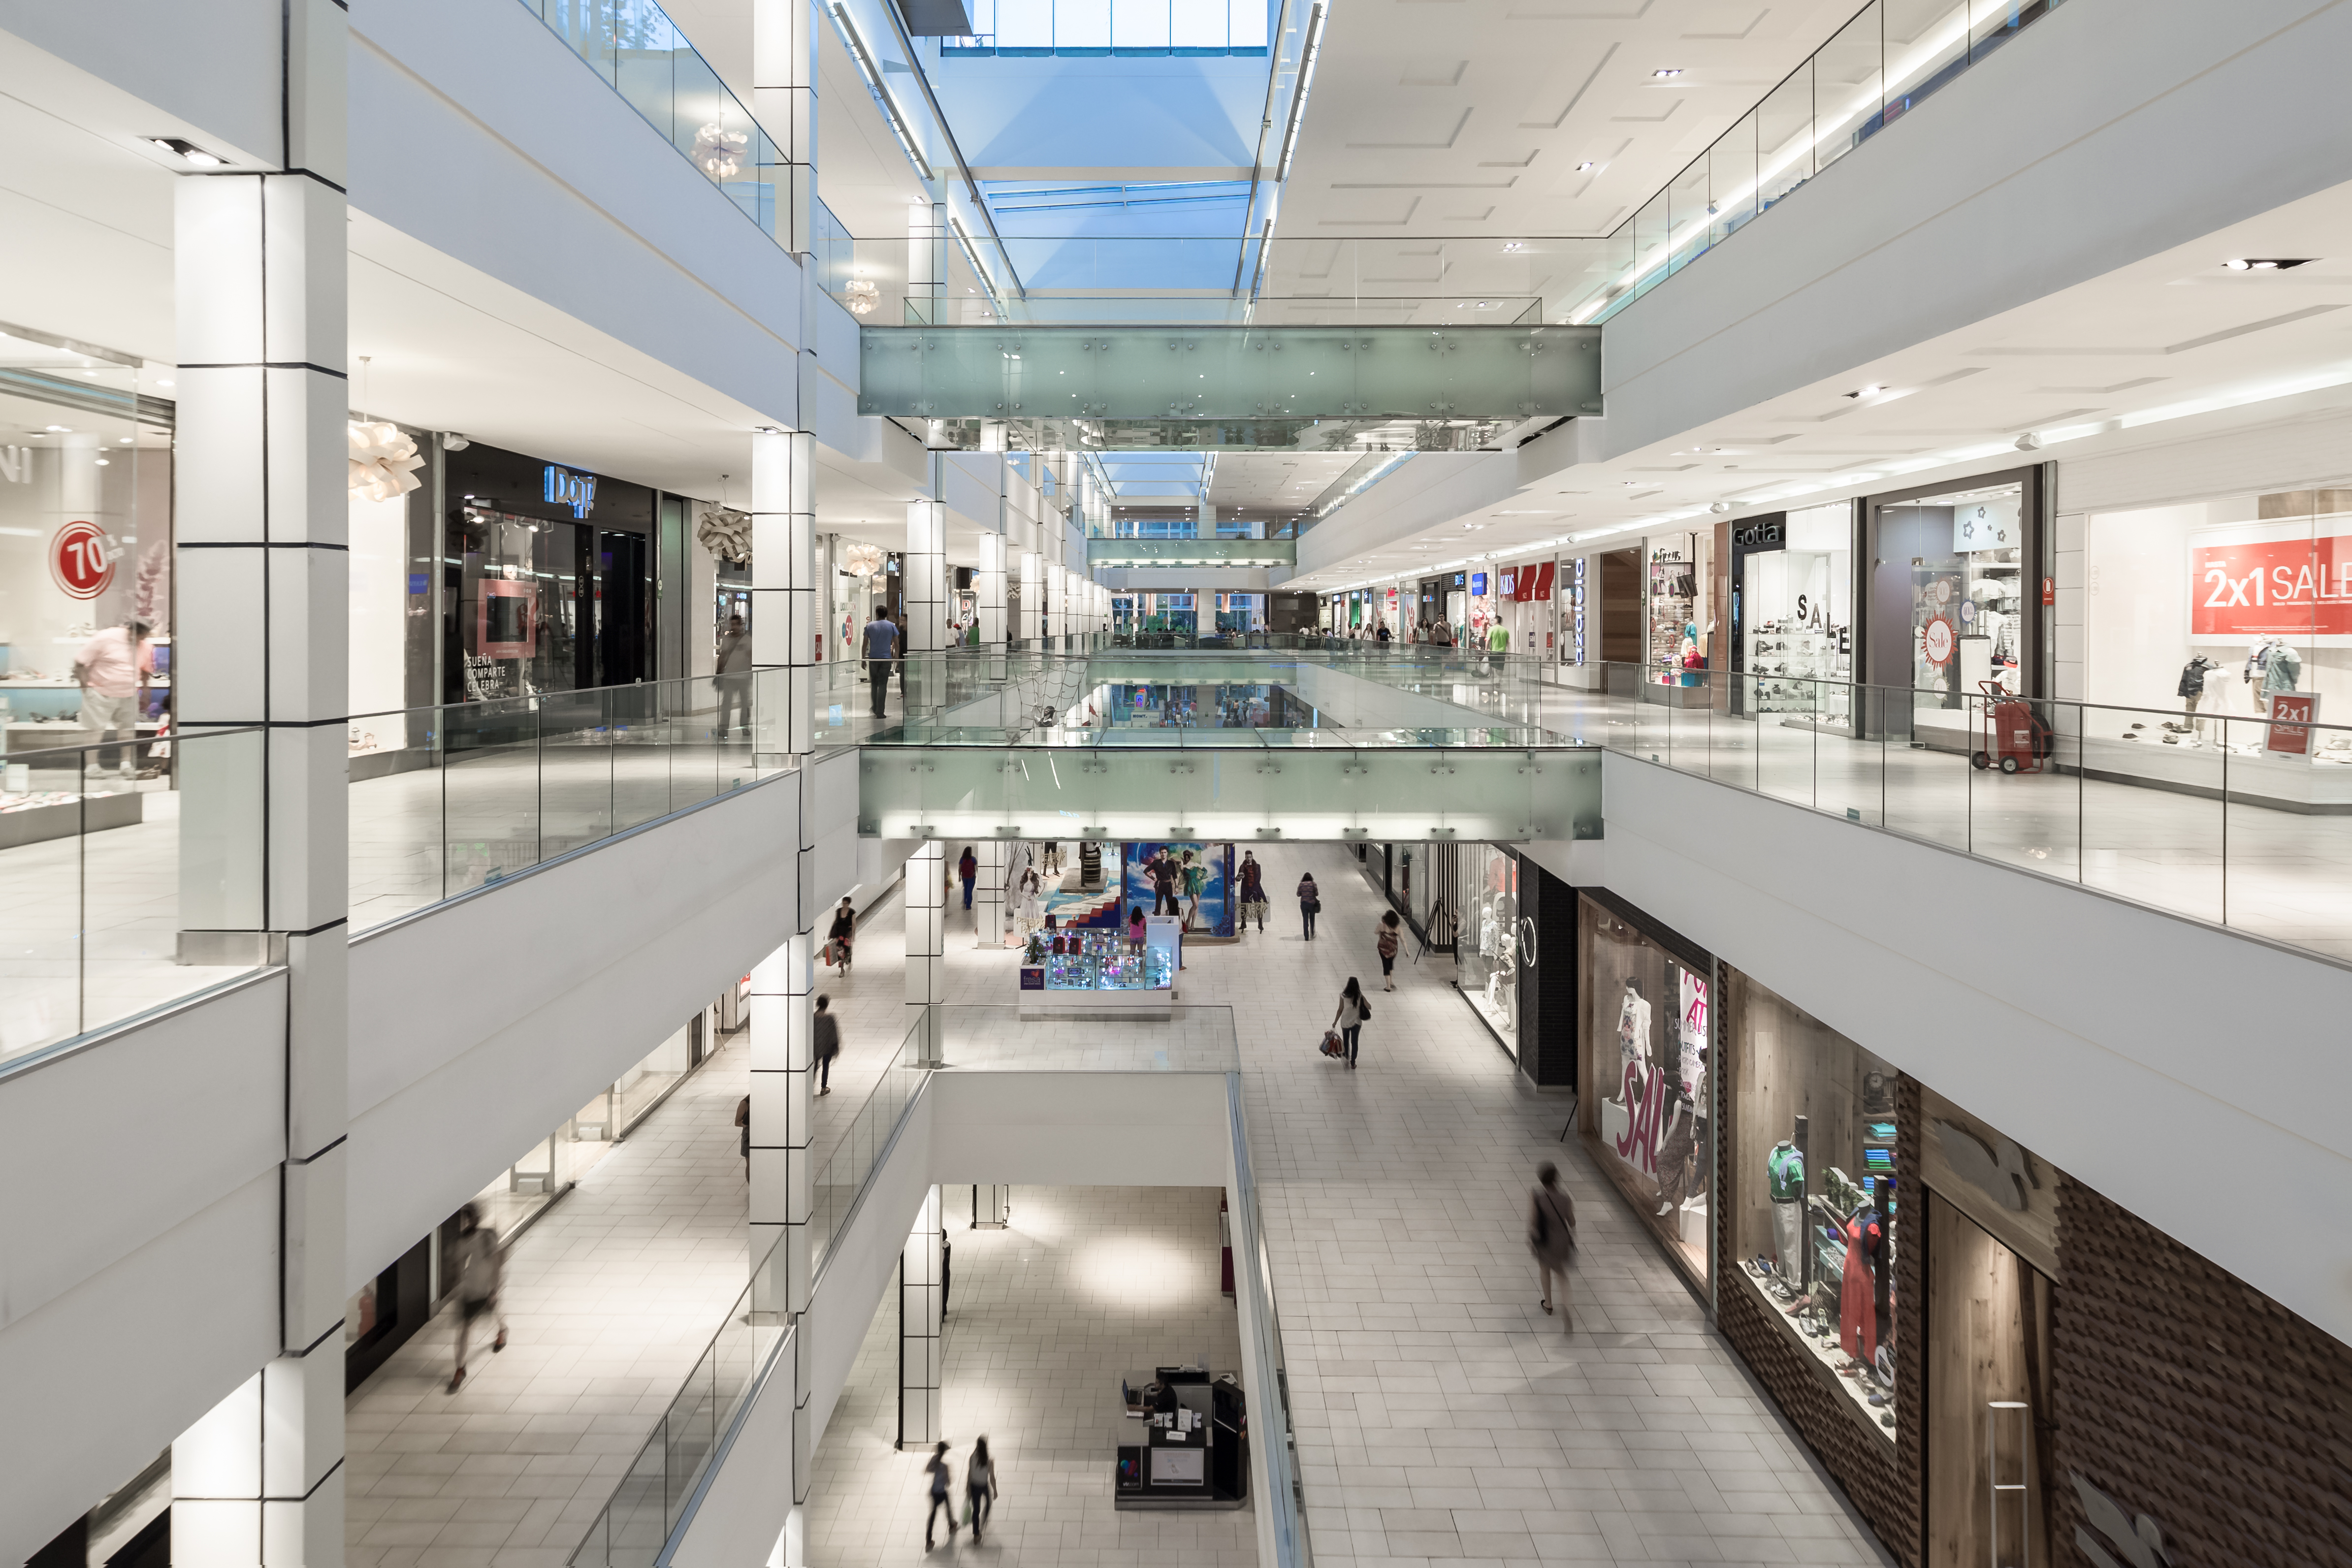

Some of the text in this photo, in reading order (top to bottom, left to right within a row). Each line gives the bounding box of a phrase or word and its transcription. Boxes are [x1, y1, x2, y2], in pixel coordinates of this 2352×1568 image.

[2203, 562, 2352, 607] 2x1 SALE
[1575, 558, 1586, 667] azaleia
[1929, 632, 1948, 648] Sale
[467, 653, 492, 667] SUEÑA
[467, 666, 506, 679] COMPARTE
[467, 679, 500, 692] CELEBRA
[2276, 704, 2309, 721] 2x1
[1235, 902, 1260, 911] PETER
[1016, 917, 1039, 927] PETER
[1241, 910, 1257, 919] PAN
[1675, 1018, 1696, 1036] SUMMER
[1616, 1060, 1673, 1175] SAL
